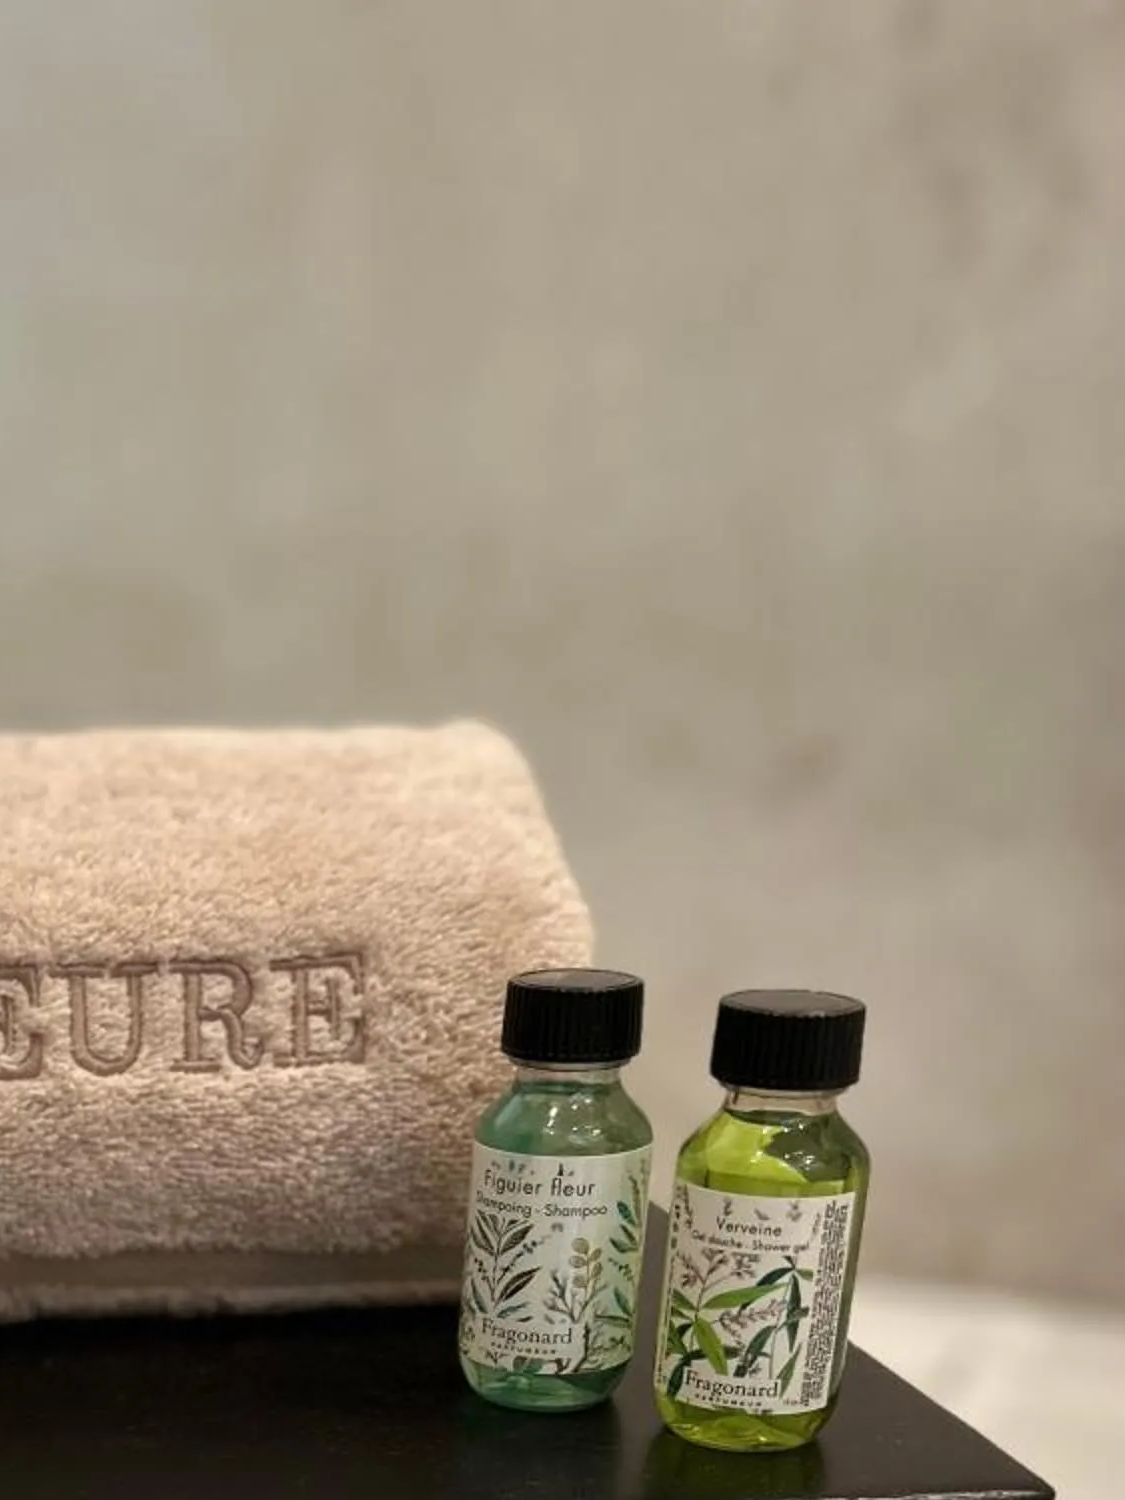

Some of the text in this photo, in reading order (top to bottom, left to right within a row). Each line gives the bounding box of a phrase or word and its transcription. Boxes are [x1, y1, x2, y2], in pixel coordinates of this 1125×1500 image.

[483, 1168, 596, 1197] Figuier fleur
[543, 1202, 608, 1220] Shampoo
[716, 1215, 782, 1238] Verveine
[482, 1317, 572, 1345] Fragonard
[686, 1368, 778, 1397] Fragonard
